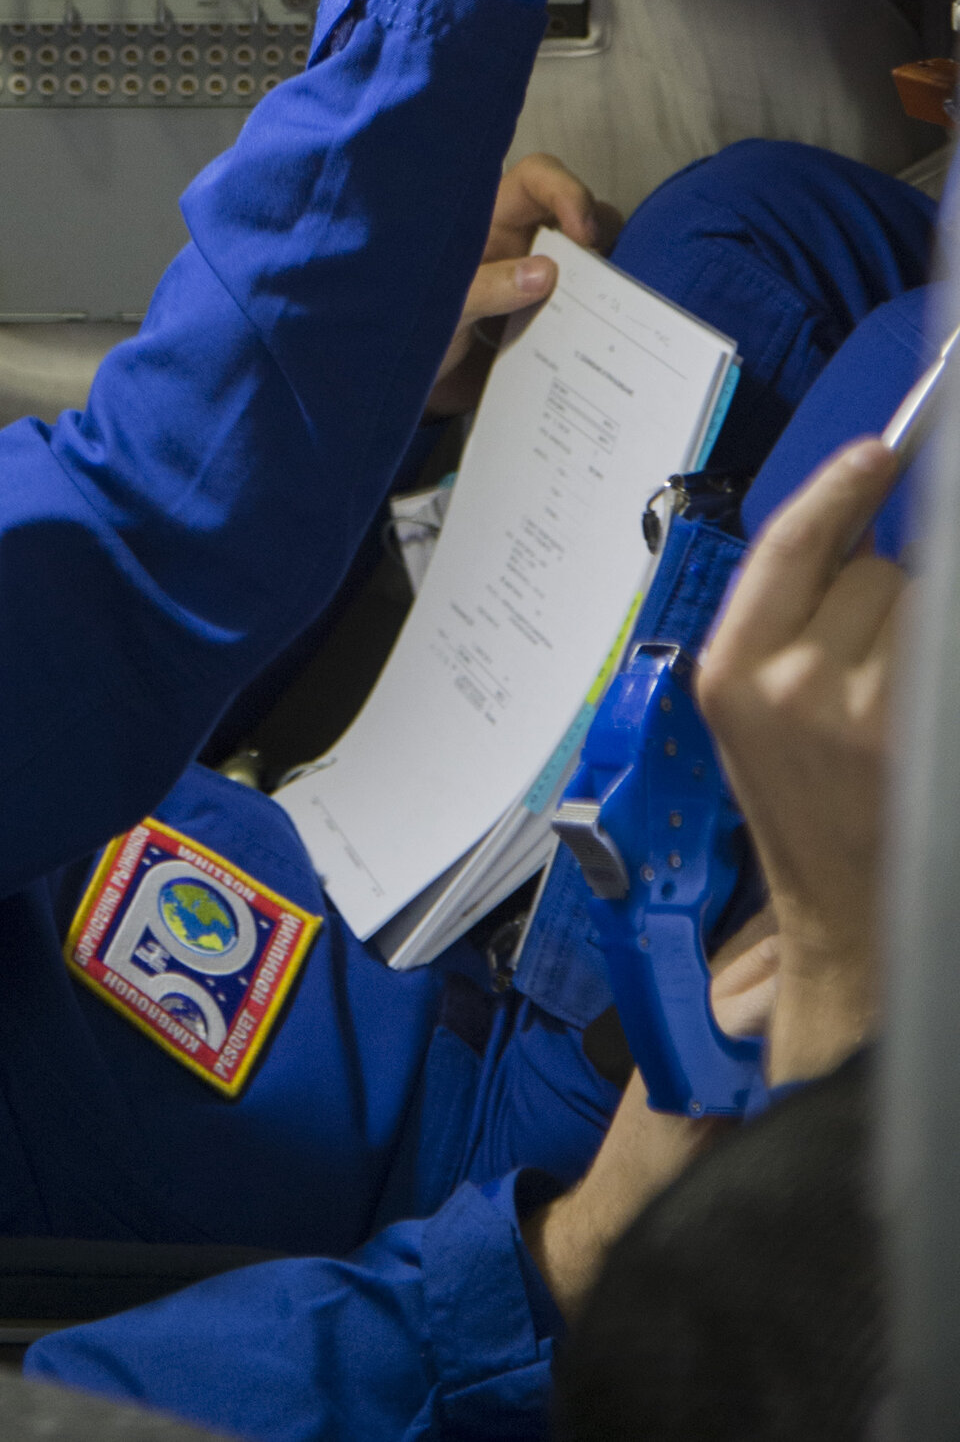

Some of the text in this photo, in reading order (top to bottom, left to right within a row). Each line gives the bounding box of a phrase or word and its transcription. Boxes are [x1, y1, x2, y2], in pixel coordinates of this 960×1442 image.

[177, 845, 257, 902] WHITSON
[103, 971, 201, 1054] KIMBROUGH
[213, 911, 302, 1079] PESQUET НОВИЦКИЙ
